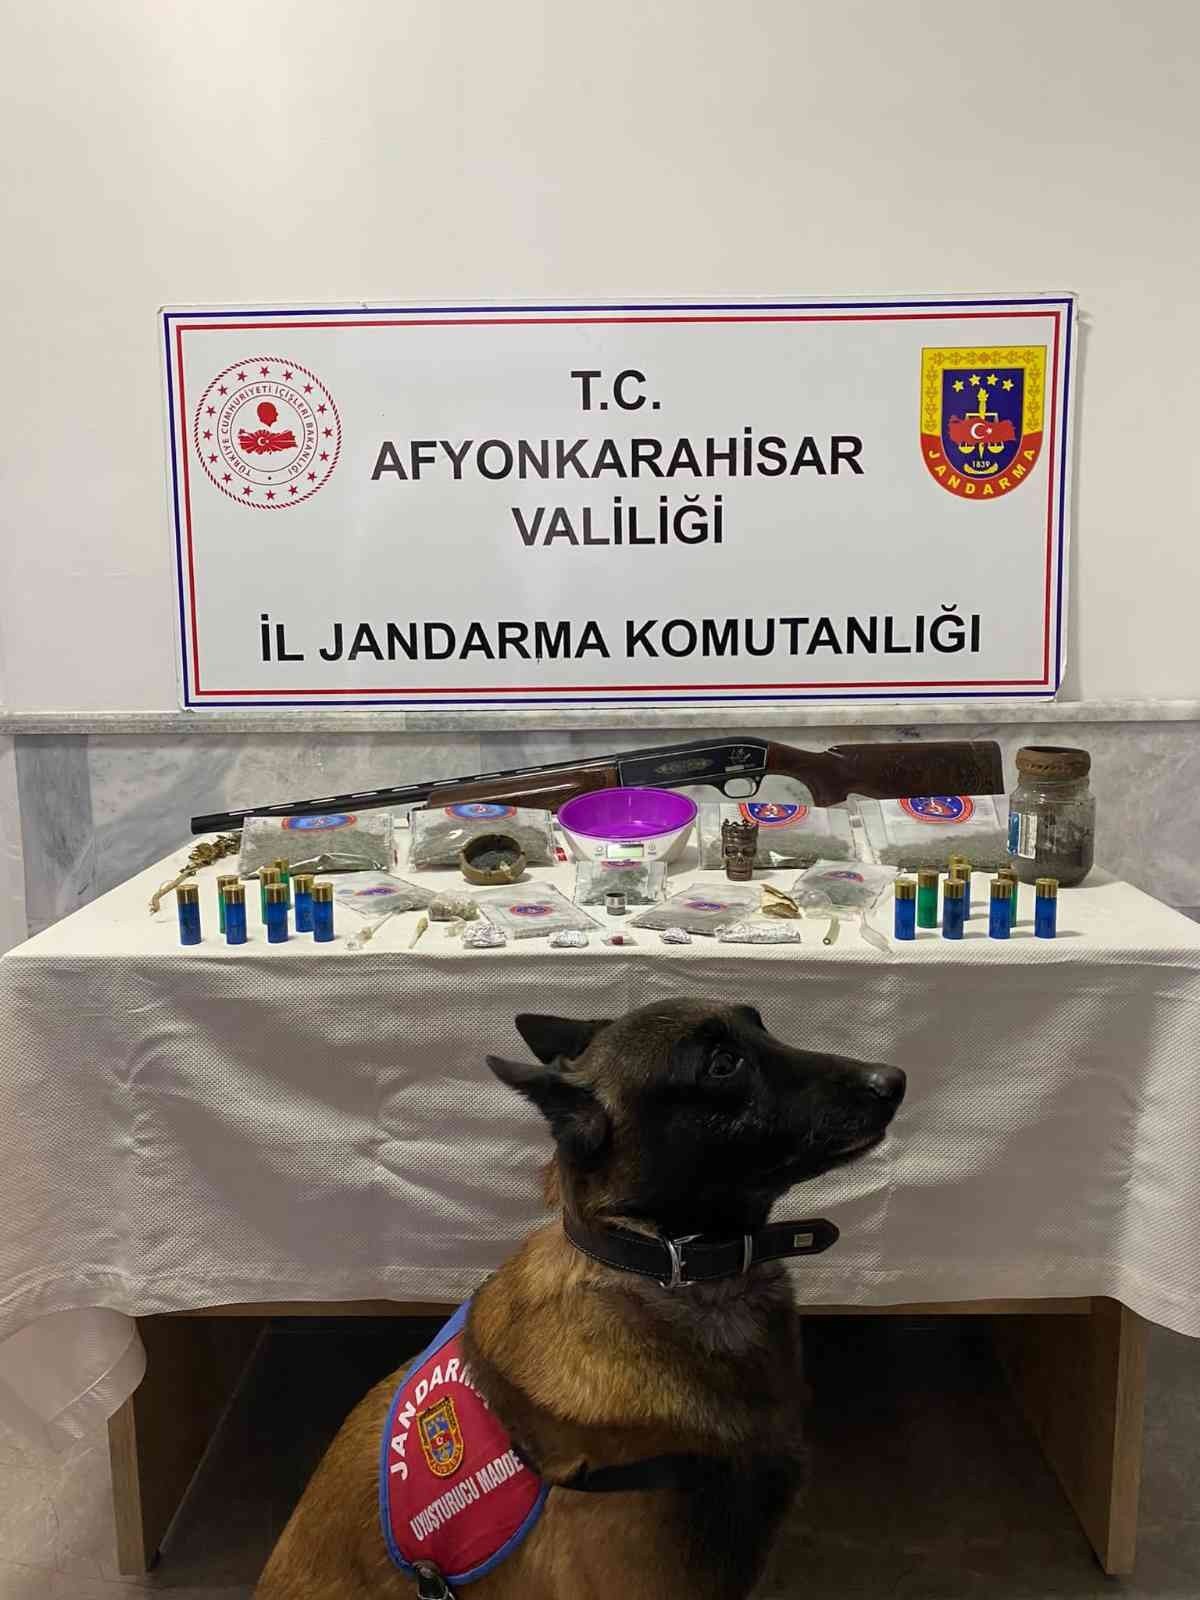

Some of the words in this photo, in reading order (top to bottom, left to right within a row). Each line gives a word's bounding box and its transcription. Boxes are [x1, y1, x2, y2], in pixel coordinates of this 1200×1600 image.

[221, 385, 272, 433] CUMHURİYETİ
[275, 385, 311, 420] İÇİŞLERİ
[570, 369, 661, 411] T.C.
[221, 439, 252, 477] TÜRKİYE
[288, 422, 315, 475] BAKANLIĞI
[371, 426, 865, 481] AFYONKARAHİSAR
[928, 448, 1036, 496] JANDARMA
[511, 494, 723, 546] VALİLİĞİ
[260, 613, 305, 662] İL
[319, 620, 611, 662] JANDARMA
[626, 603, 980, 660] KOMUTANLIĞI
[409, 1477, 481, 1541] UYUŞTURUCU
[475, 1449, 524, 1494] MADDE
